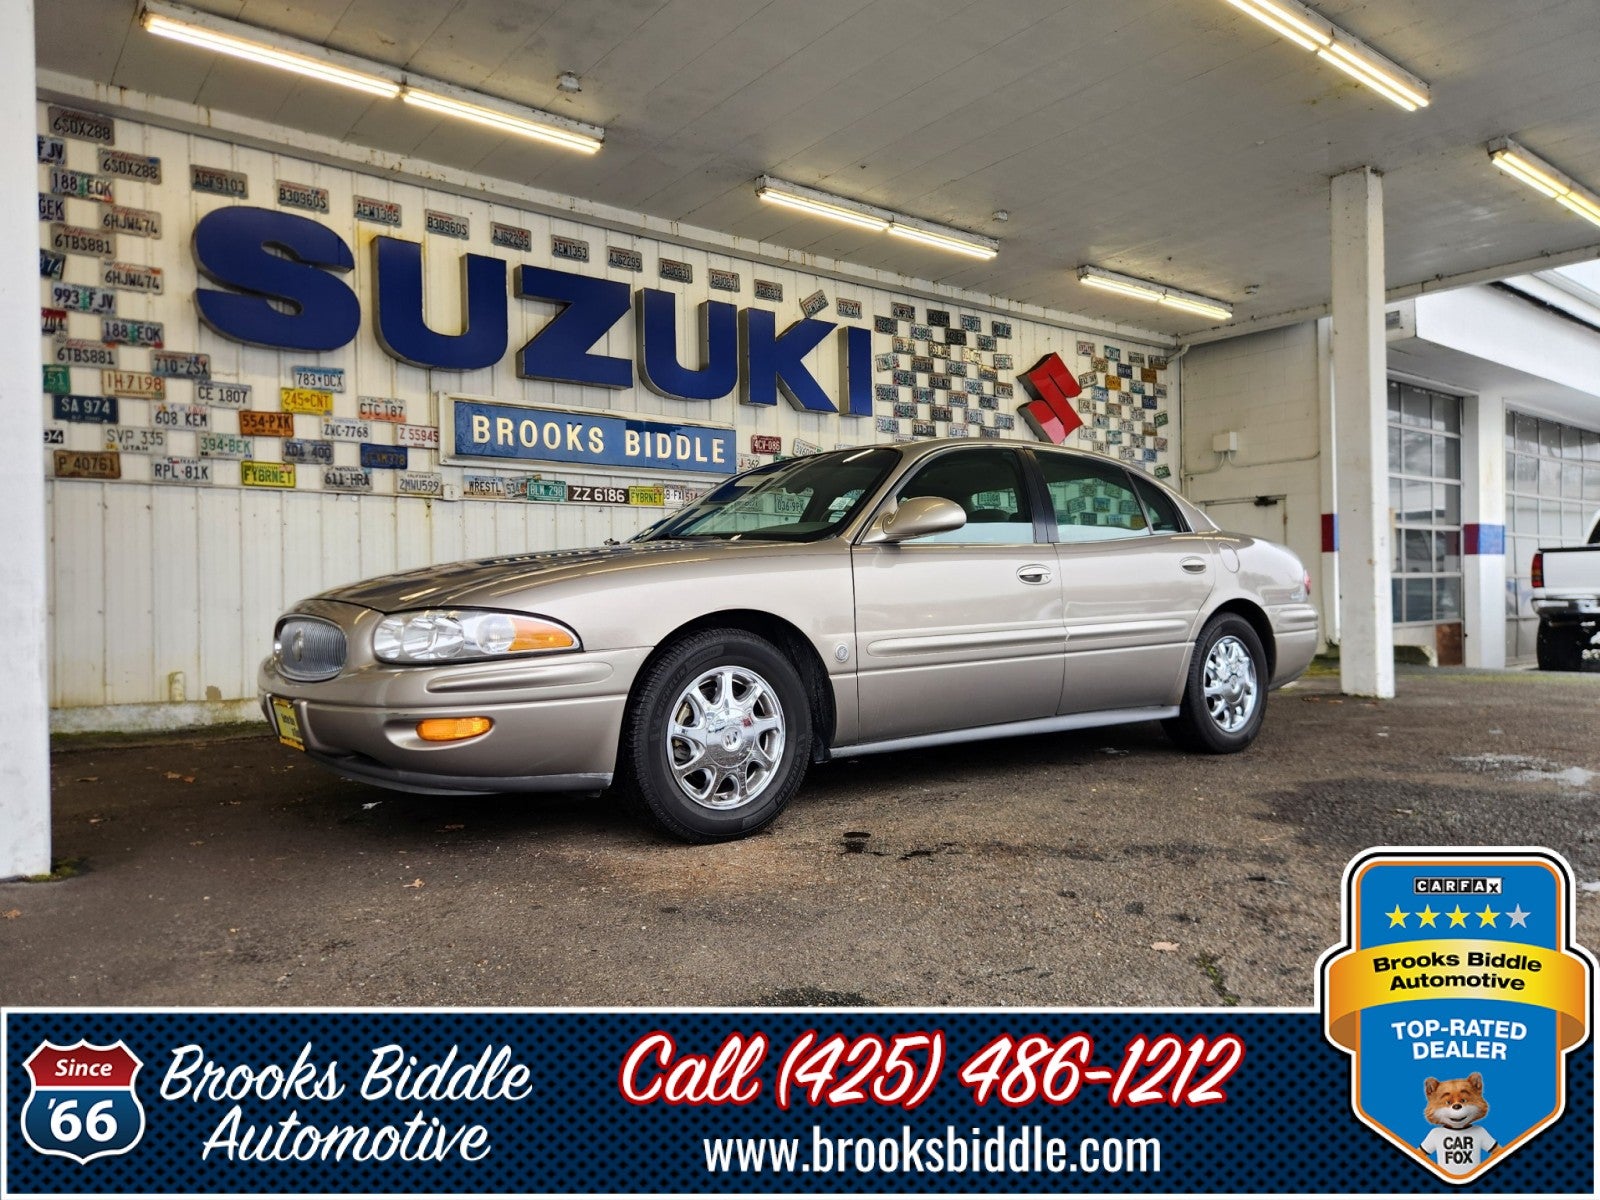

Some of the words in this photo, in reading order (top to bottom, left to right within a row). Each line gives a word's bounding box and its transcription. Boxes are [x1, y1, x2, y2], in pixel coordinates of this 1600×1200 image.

[54, 288, 80, 304] 993
[193, 206, 874, 417] SUZUKI
[105, 322, 128, 338] 188
[198, 386, 214, 401] CE
[219, 388, 248, 404] 1807
[62, 399, 79, 412] SA
[84, 400, 110, 414] 974
[360, 403, 381, 416] CTC
[155, 411, 178, 425] 608
[107, 429, 133, 443] SVP
[141, 430, 163, 446] 335
[409, 428, 439, 443] 55945
[472, 415, 605, 454] BROOKS
[625, 429, 725, 463] BIDDLE
[573, 487, 591, 501] ZZ
[594, 488, 625, 502] 6186
